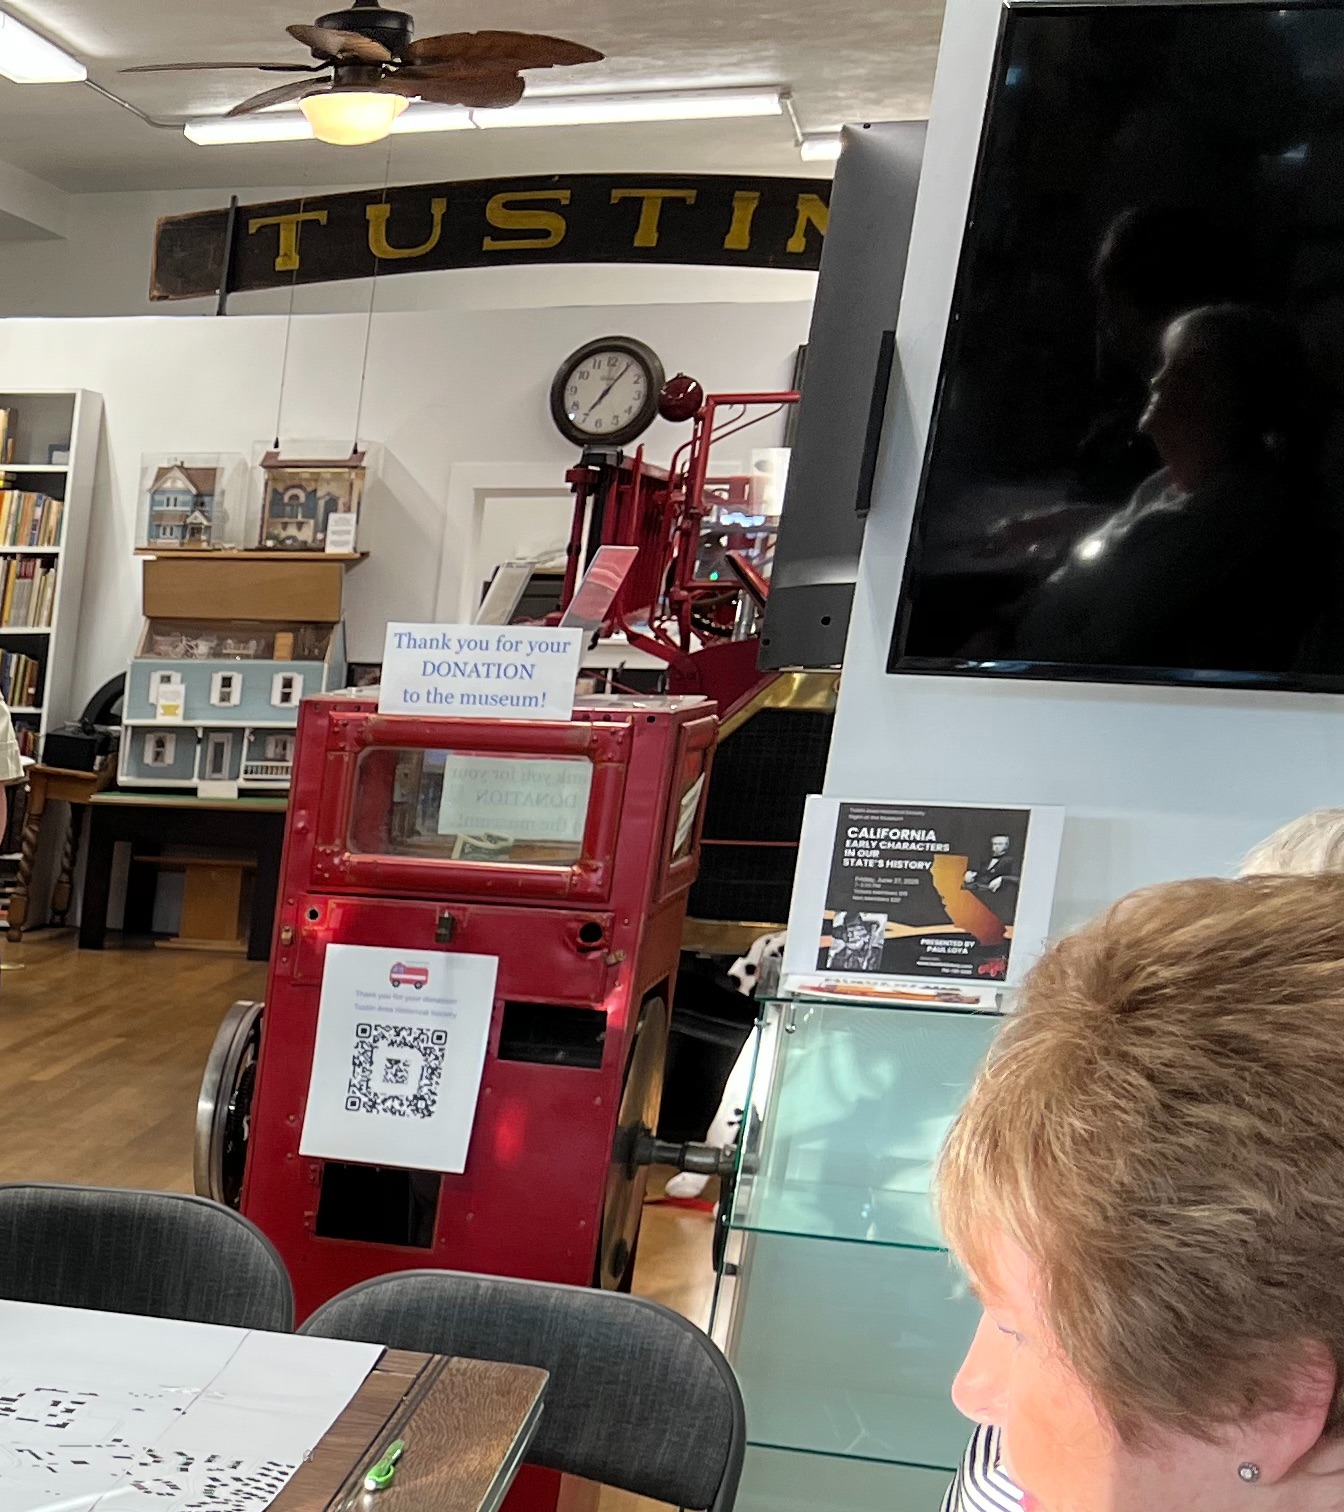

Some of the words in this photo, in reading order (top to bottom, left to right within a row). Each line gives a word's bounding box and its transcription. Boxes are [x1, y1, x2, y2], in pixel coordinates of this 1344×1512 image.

[607, 358, 618, 367] 12
[578, 371, 590, 380] 10
[394, 632, 451, 650] Thank
[455, 637, 489, 653] you
[496, 635, 523, 652] for
[526, 640, 571, 656] your
[421, 661, 535, 680] DONATION
[403, 688, 420, 703] to
[426, 687, 454, 704] the
[460, 692, 546, 708] museum!
[847, 827, 936, 841] CALIFORNIA
[845, 840, 877, 848] EARLY
[879, 842, 950, 852] CHARACTERS
[844, 849, 855, 857] IN
[843, 859, 884, 867] STATE'S
[886, 860, 932, 869] HISTORY
